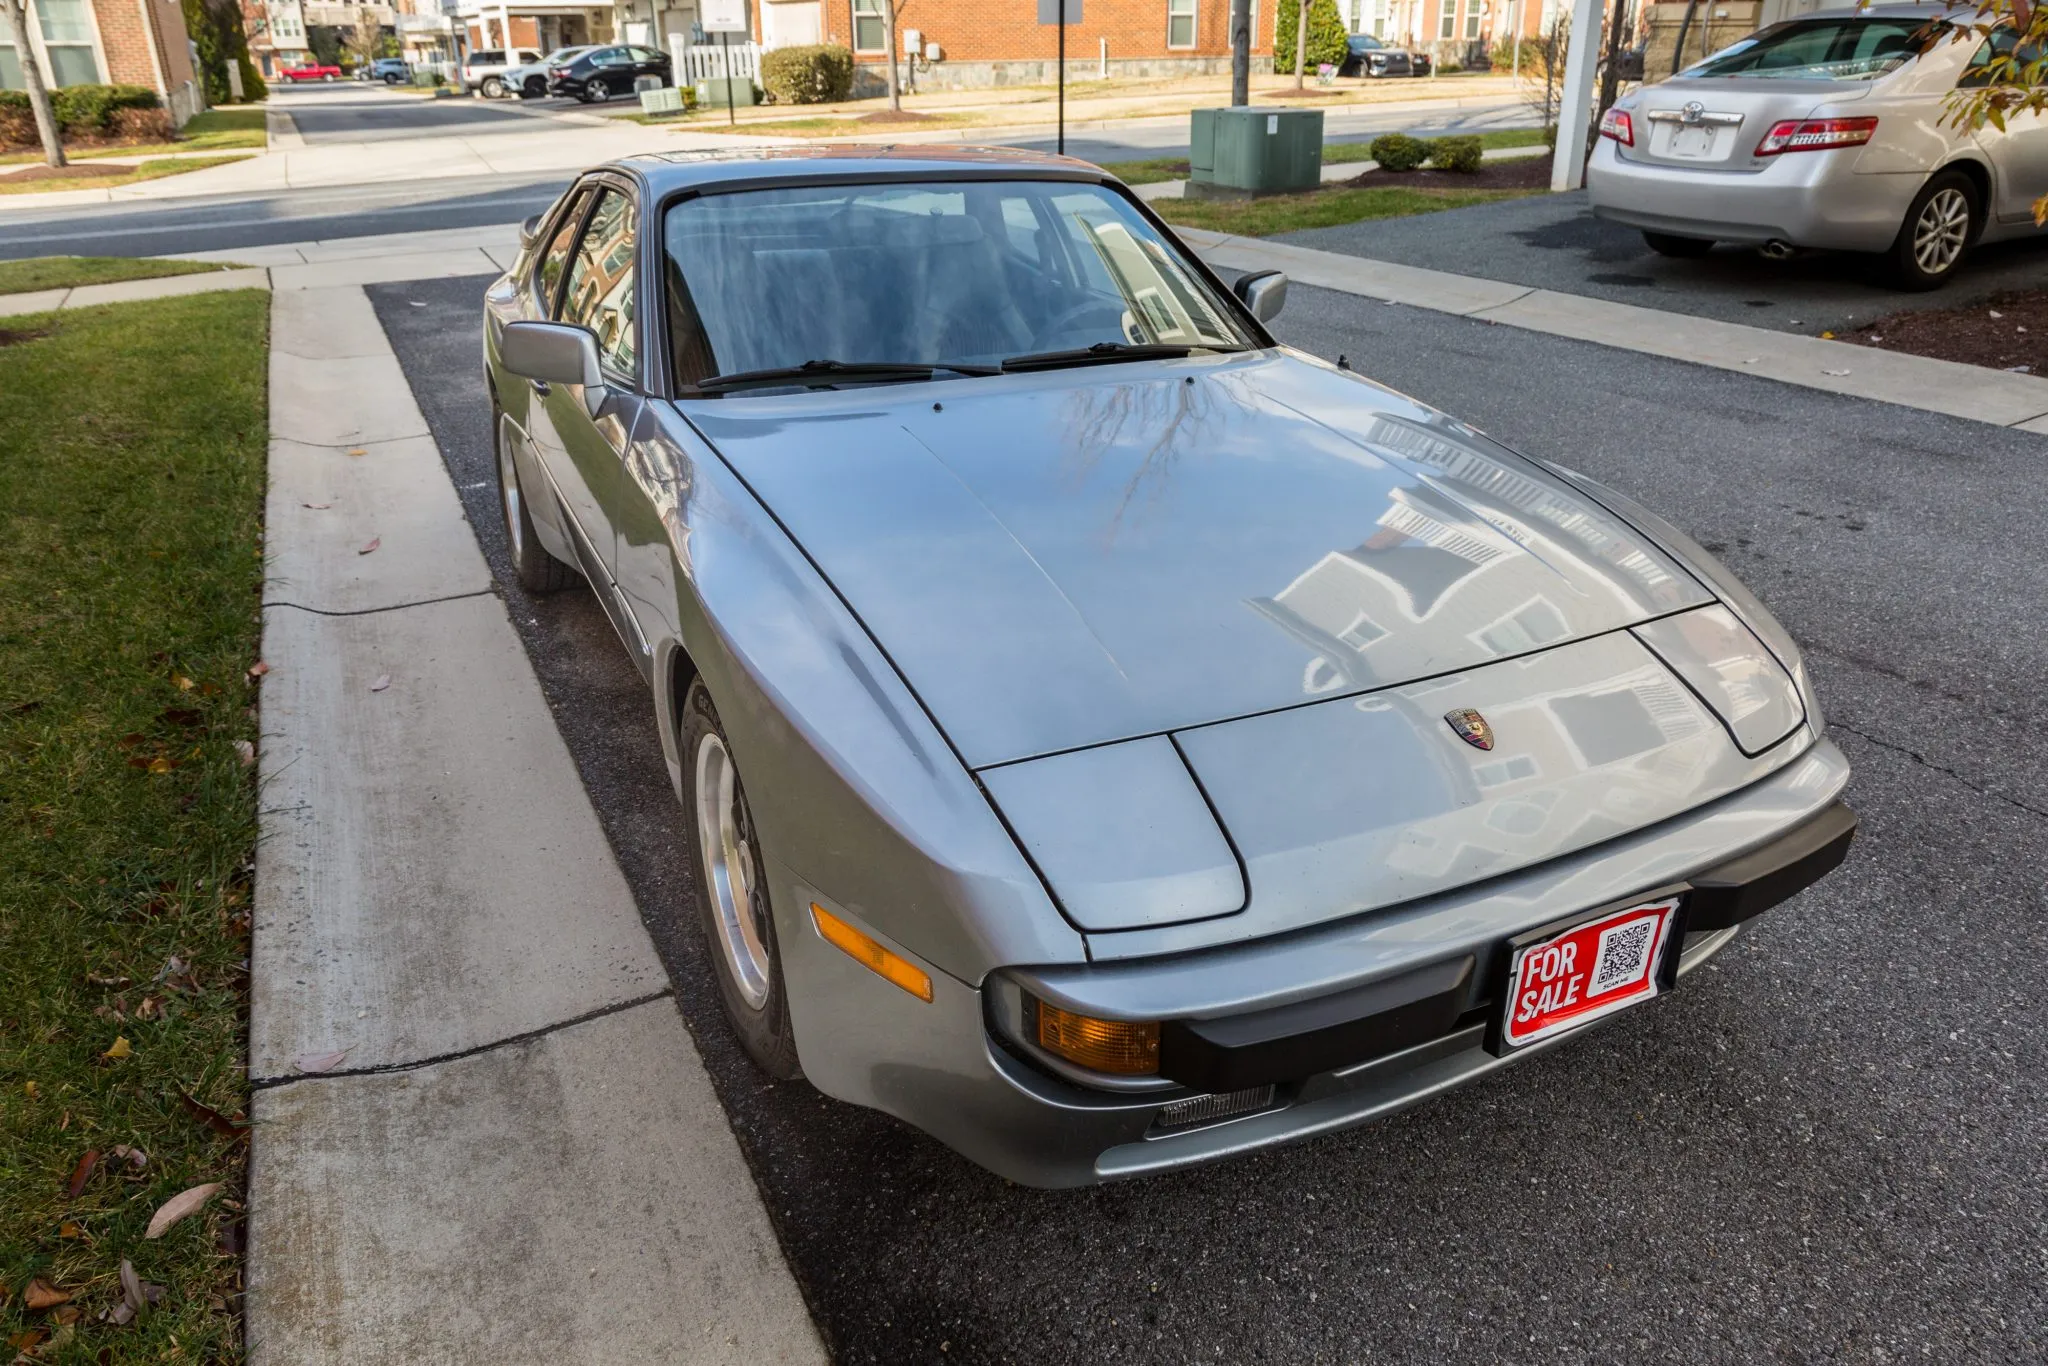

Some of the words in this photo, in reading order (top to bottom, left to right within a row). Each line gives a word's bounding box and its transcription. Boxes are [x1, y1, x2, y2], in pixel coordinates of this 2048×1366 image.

[1524, 941, 1578, 989] FOR
[1602, 979, 1619, 990] SCAN
[1619, 976, 1629, 984] ME
[1517, 973, 1584, 1024] SALE
